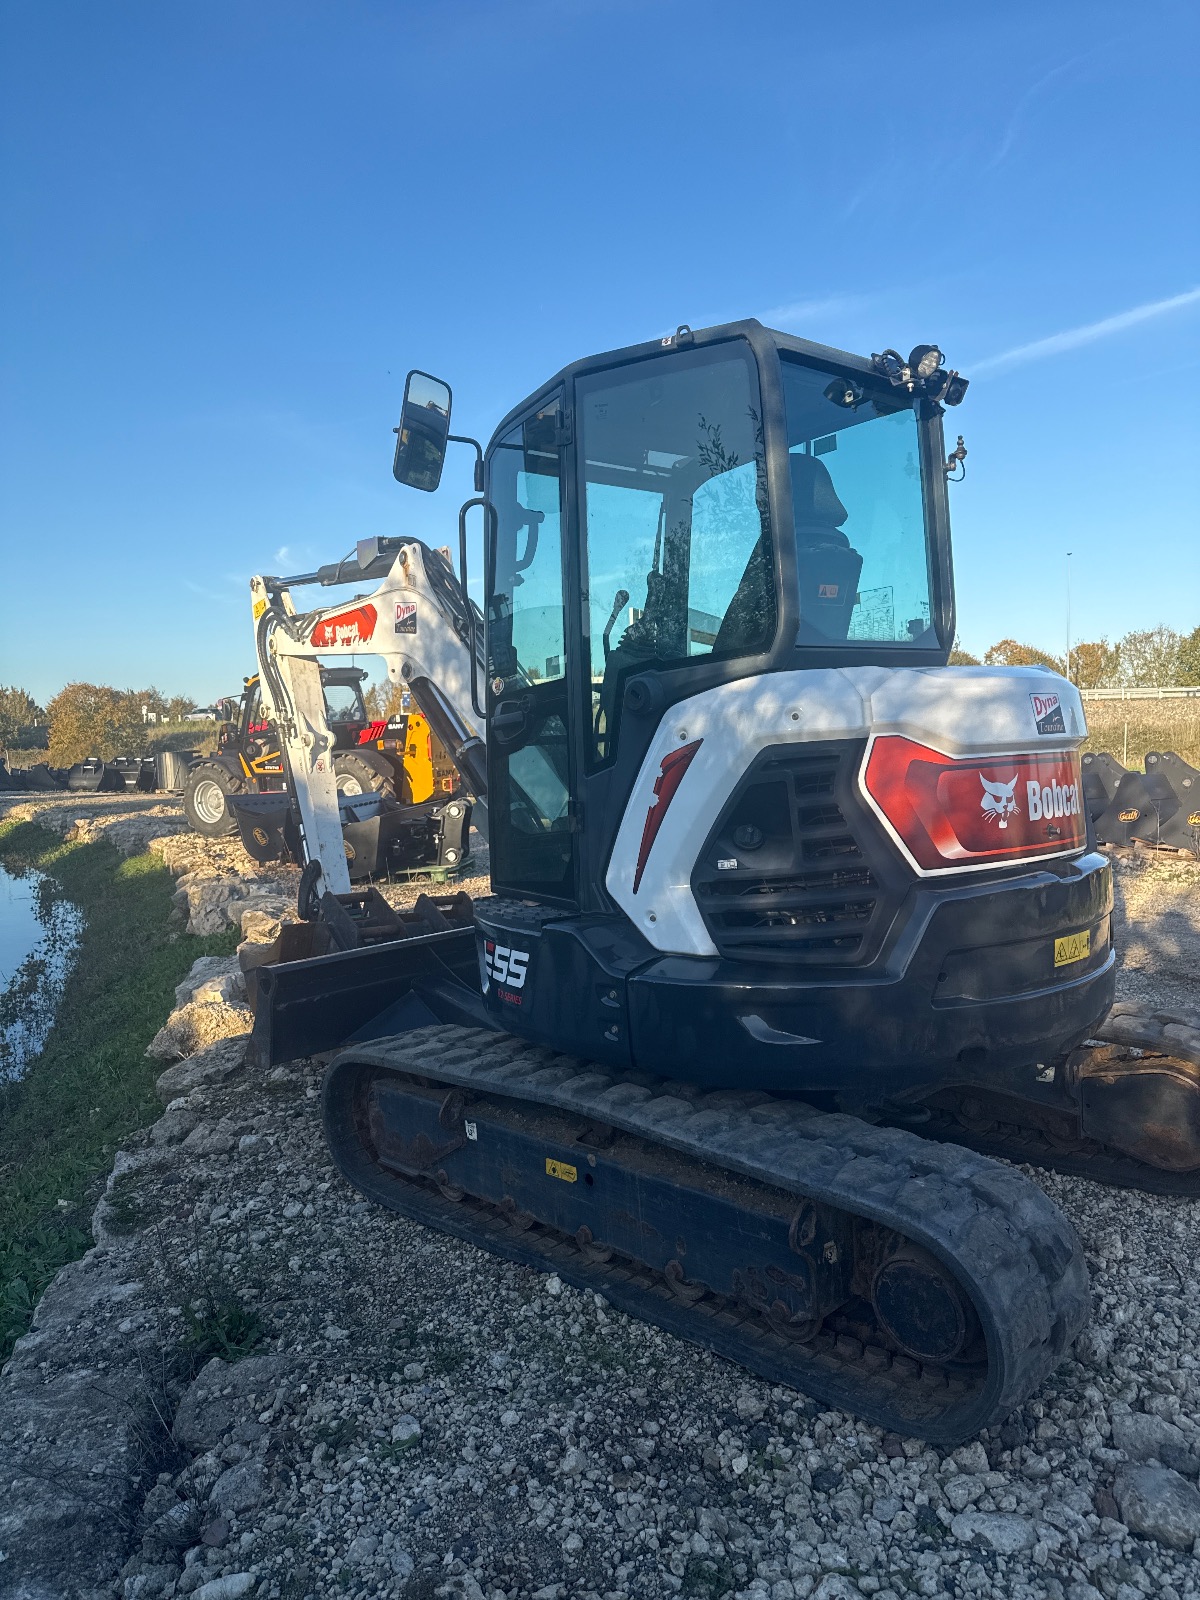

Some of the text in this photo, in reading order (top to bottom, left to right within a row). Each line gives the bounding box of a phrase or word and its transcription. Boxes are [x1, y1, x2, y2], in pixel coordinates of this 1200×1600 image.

[396, 604, 415, 620] Dyna
[335, 621, 360, 639] Bobcat
[1033, 696, 1058, 716] Dyna
[436, 769, 456, 777] SANY
[1026, 778, 1081, 821] Bobcat
